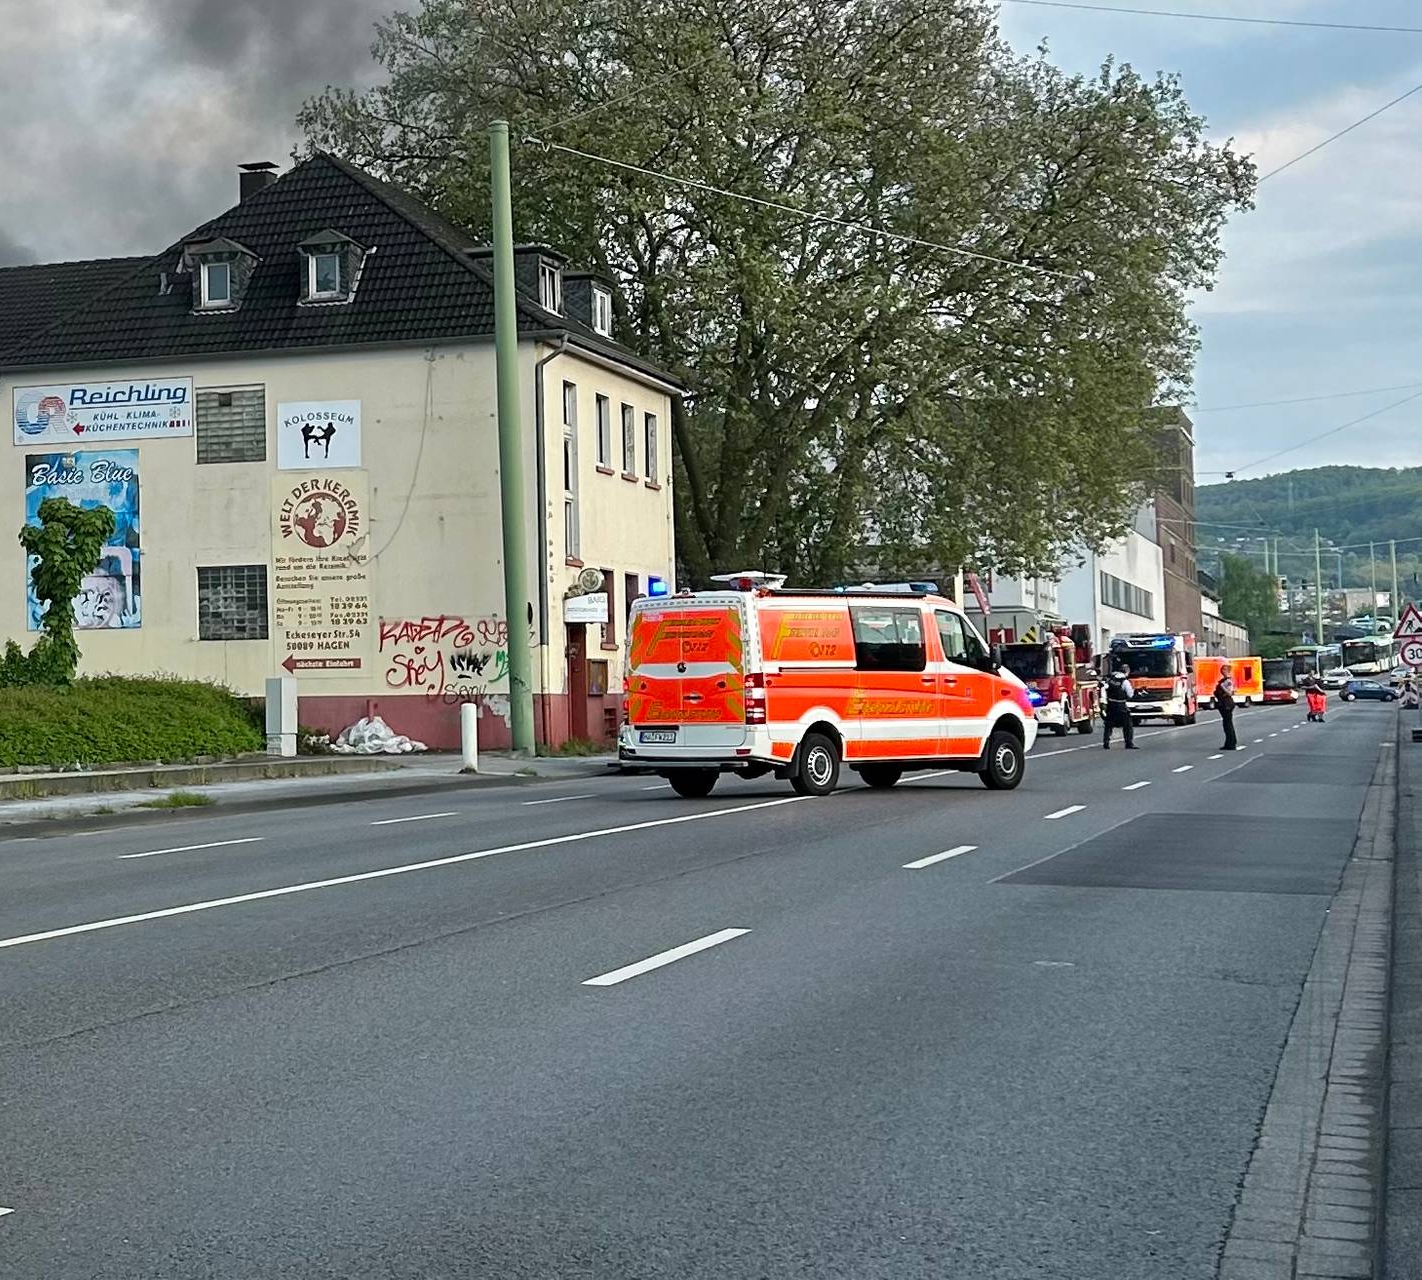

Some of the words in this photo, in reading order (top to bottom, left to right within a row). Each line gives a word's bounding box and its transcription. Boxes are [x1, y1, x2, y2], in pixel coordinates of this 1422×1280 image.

[69, 384, 187, 406] Reichling
[85, 421, 168, 432] KÜCHENTECHNIK
[283, 411, 355, 428] KOLOSSEUM
[31, 463, 85, 486] Basic
[90, 459, 134, 483] Blue
[279, 499, 294, 538] WELT
[291, 479, 320, 500] DER
[323, 478, 360, 537] KERAMIK
[285, 630, 332, 640] Eckeseyer
[318, 641, 350, 650] HAGEN
[1407, 648, 1422, 660] 30
